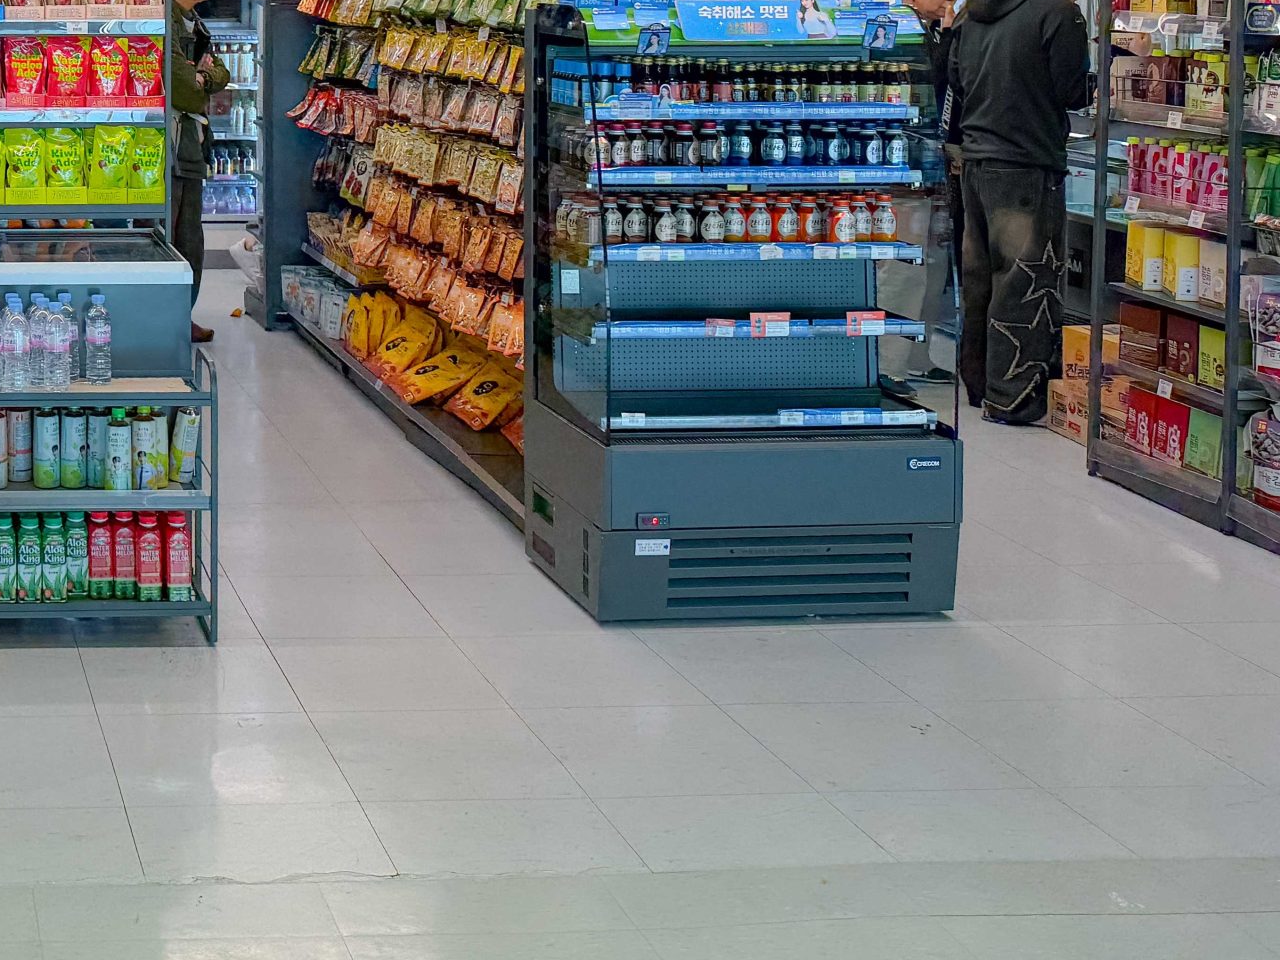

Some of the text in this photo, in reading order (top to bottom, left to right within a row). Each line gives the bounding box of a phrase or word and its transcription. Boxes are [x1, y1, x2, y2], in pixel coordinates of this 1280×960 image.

[698, 6, 788, 19] 숙취해소 맛집
[67, 538, 87, 547] Aloe
[19, 545, 40, 554] Aloe
[44, 545, 65, 554] Aloe
[67, 546, 88, 557] King
[20, 554, 40, 564] King
[44, 554, 66, 564] King
